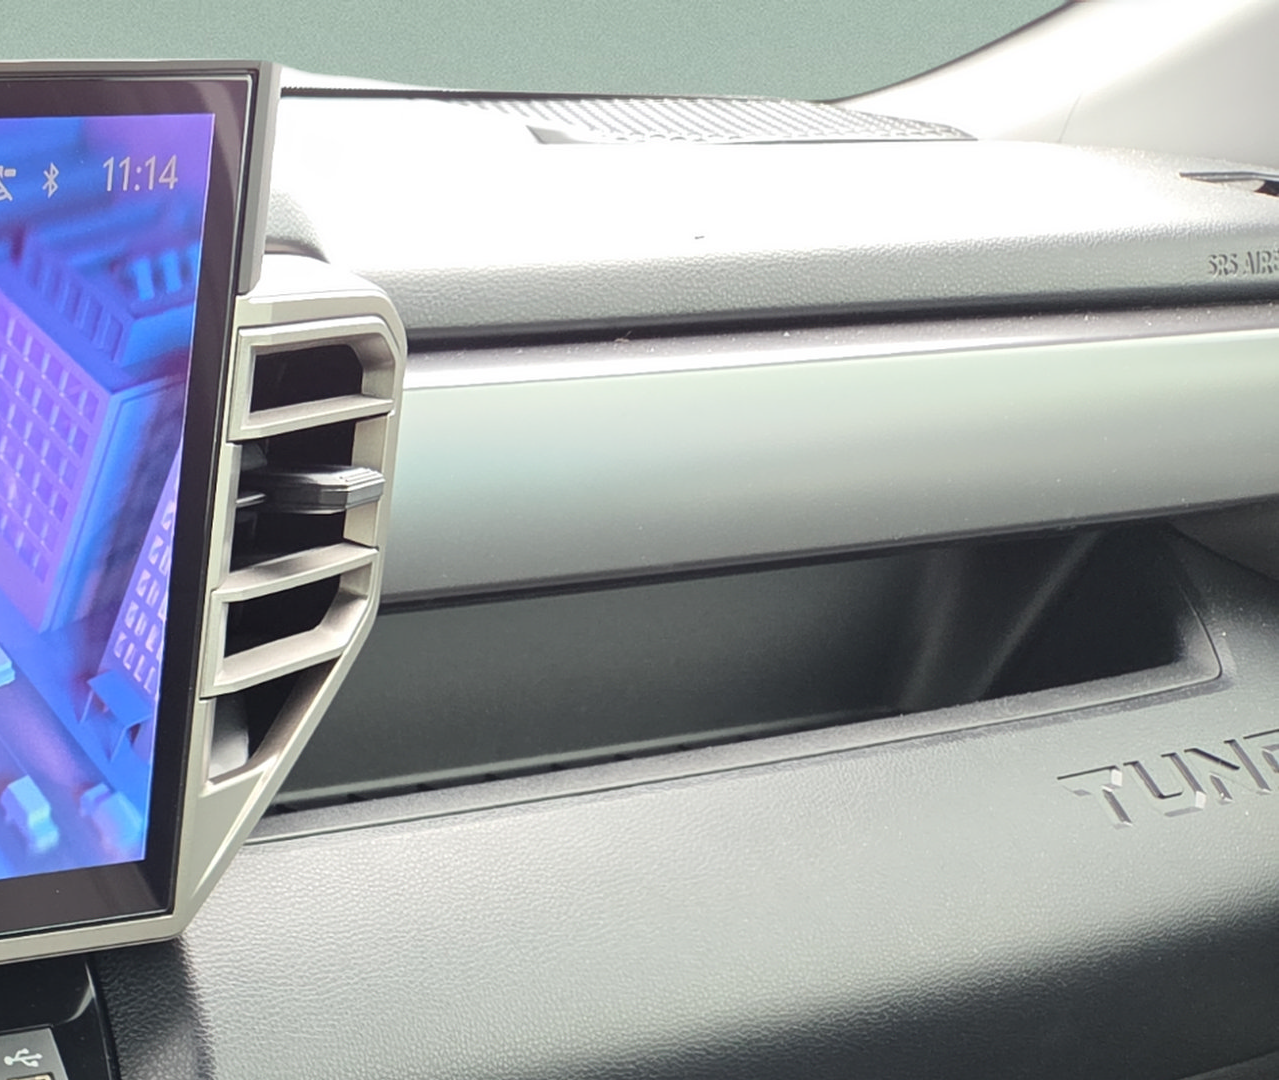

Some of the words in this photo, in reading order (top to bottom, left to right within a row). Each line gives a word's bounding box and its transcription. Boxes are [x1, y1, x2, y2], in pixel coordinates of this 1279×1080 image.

[104, 155, 178, 191] 11:14
[1207, 253, 1239, 277] SRS
[1243, 249, 1279, 276] AIR
